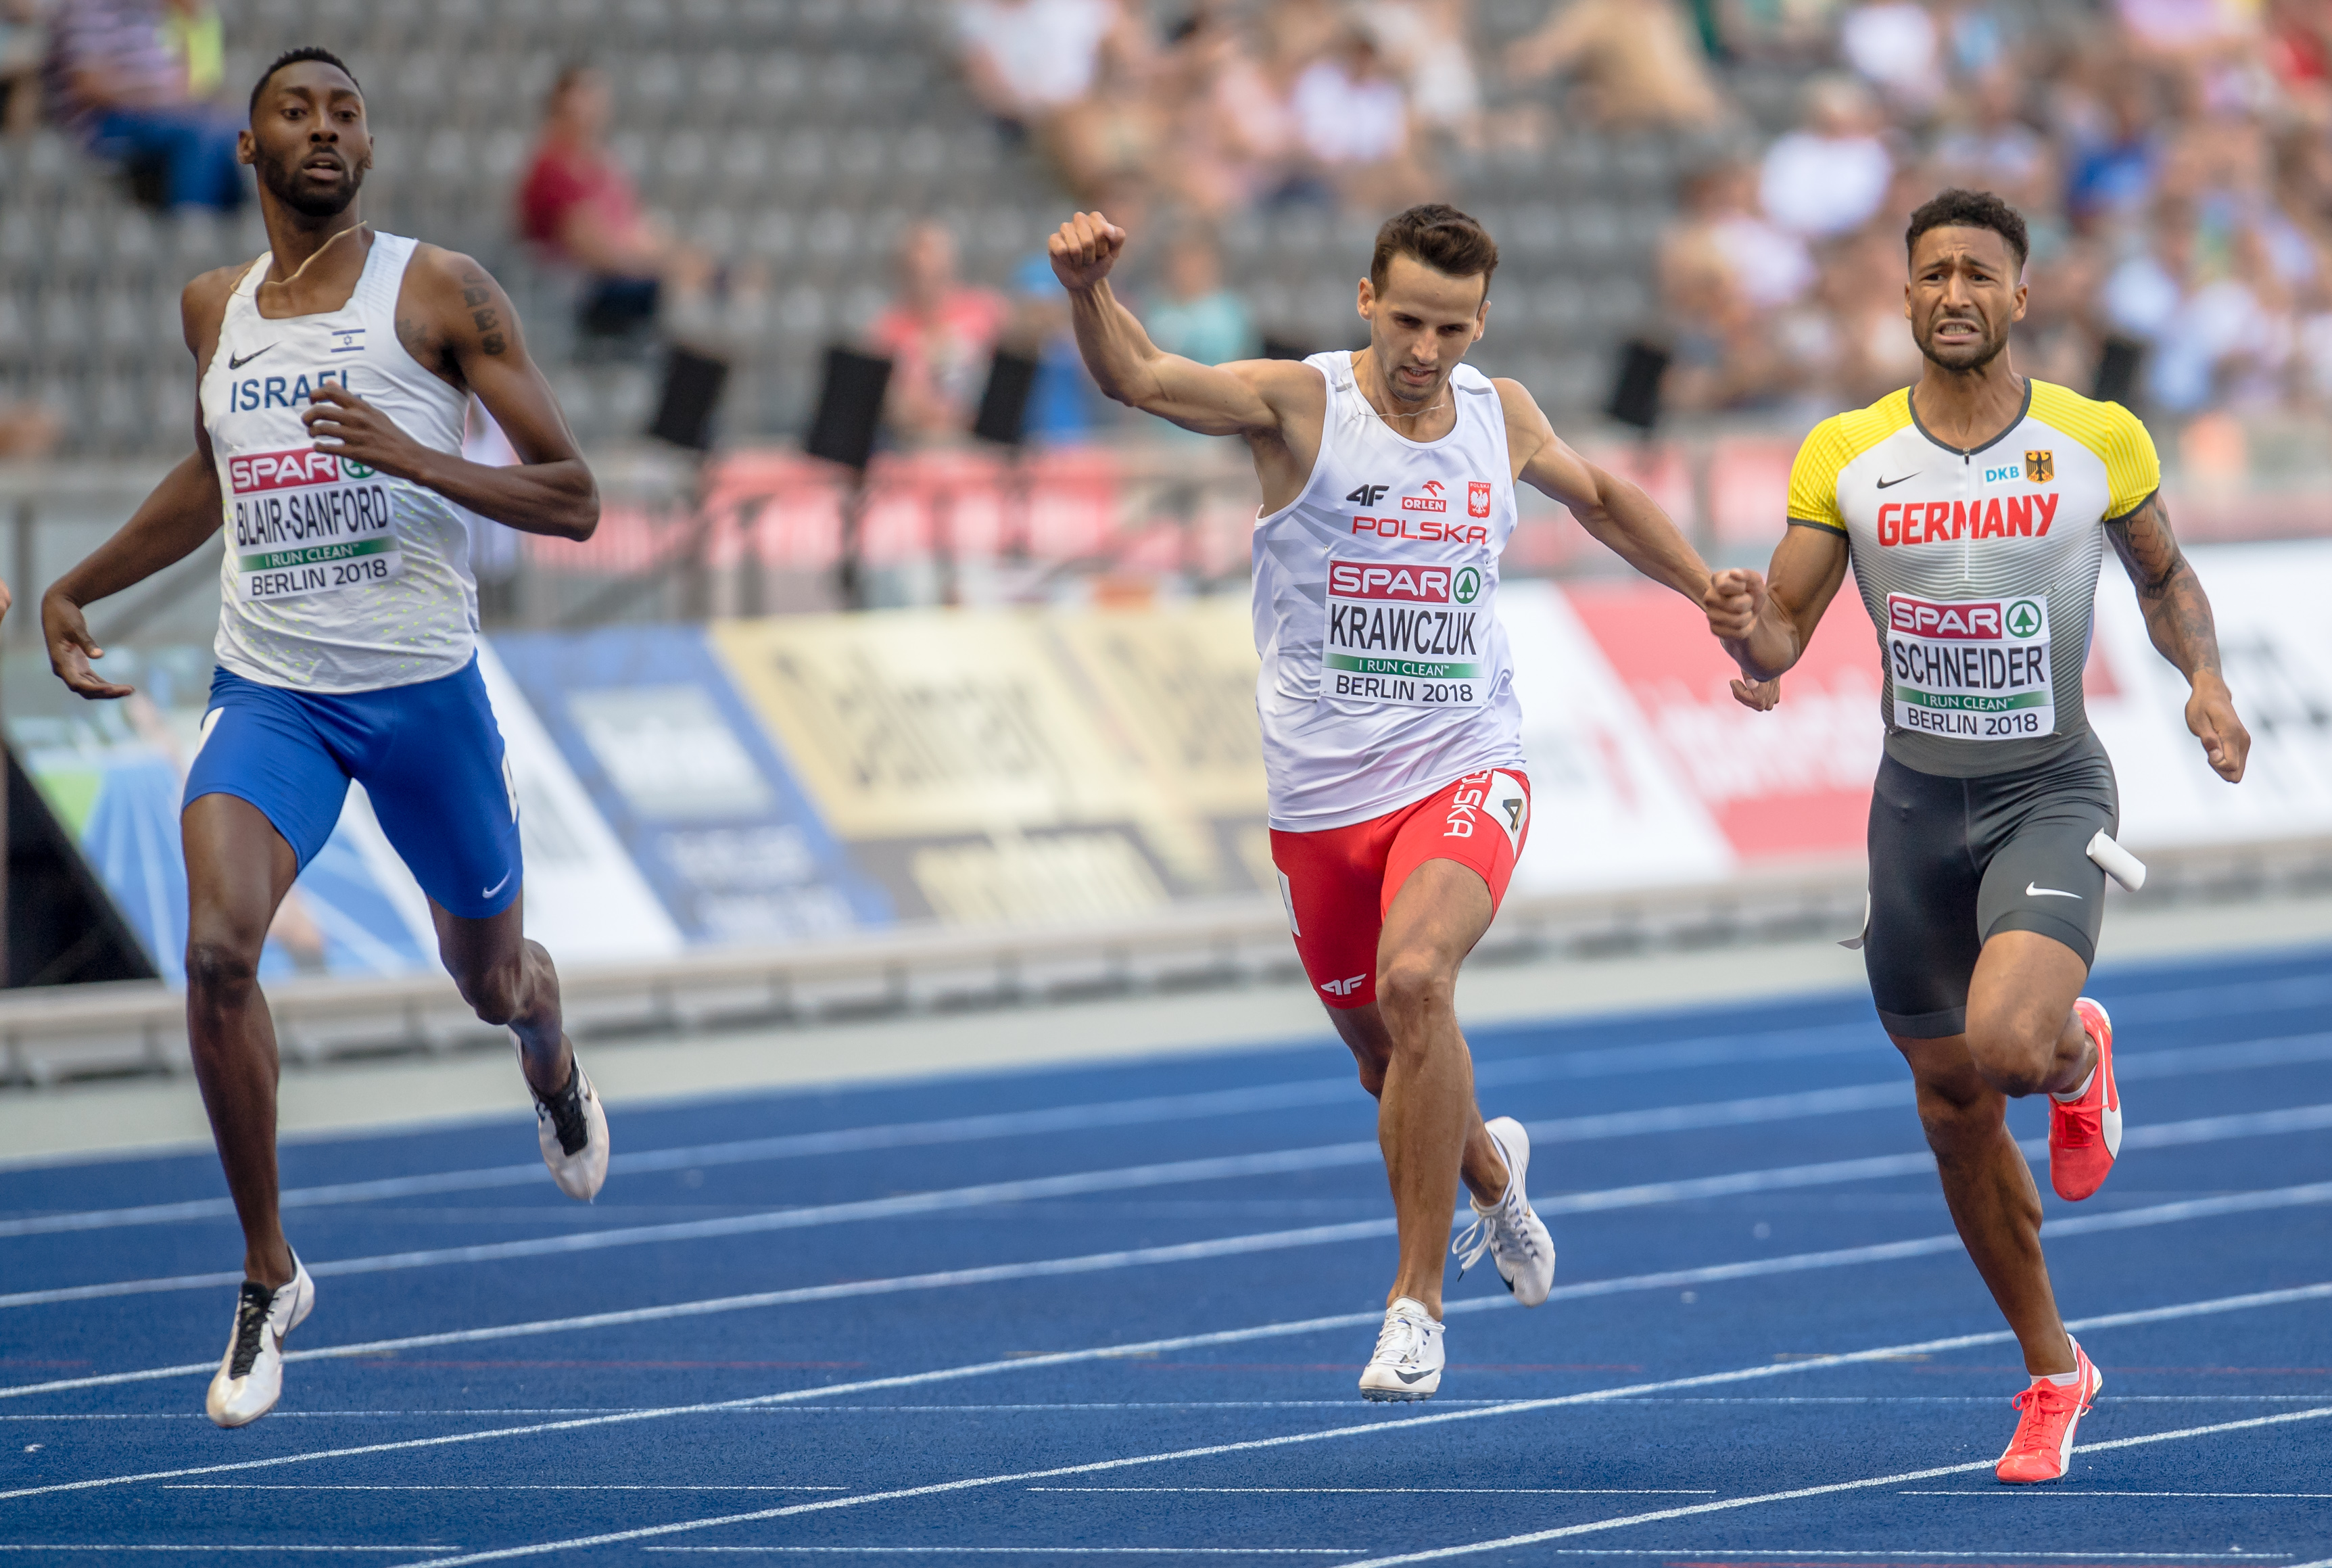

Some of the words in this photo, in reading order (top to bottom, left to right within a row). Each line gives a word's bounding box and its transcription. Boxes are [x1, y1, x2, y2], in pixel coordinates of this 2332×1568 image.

[232, 455, 337, 490] SPAR
[1985, 465, 2020, 483] DKB
[237, 485, 387, 546] BLAIR-SANFORD
[1404, 498, 1444, 511] ORLEN
[1352, 516, 1487, 544] POLSKA
[1877, 493, 2059, 547] GERMANY
[271, 550, 304, 566] RUN
[252, 568, 326, 596] BERLIN
[332, 559, 387, 586] 2018
[1333, 565, 1447, 597] SPAR
[1329, 604, 1477, 655] KRAWCZUK
[1891, 603, 2000, 635] SPAR
[1358, 660, 1362, 670] I
[1367, 661, 1398, 672] RUN
[1893, 640, 2045, 690] SCHNEIDER
[1336, 674, 1414, 701] BERLIN
[1422, 683, 1473, 703] 2018
[1923, 694, 1926, 705] I
[1930, 695, 1959, 708] RUN
[1908, 707, 1977, 734] BERLIN
[1984, 713, 2039, 736] 2018
